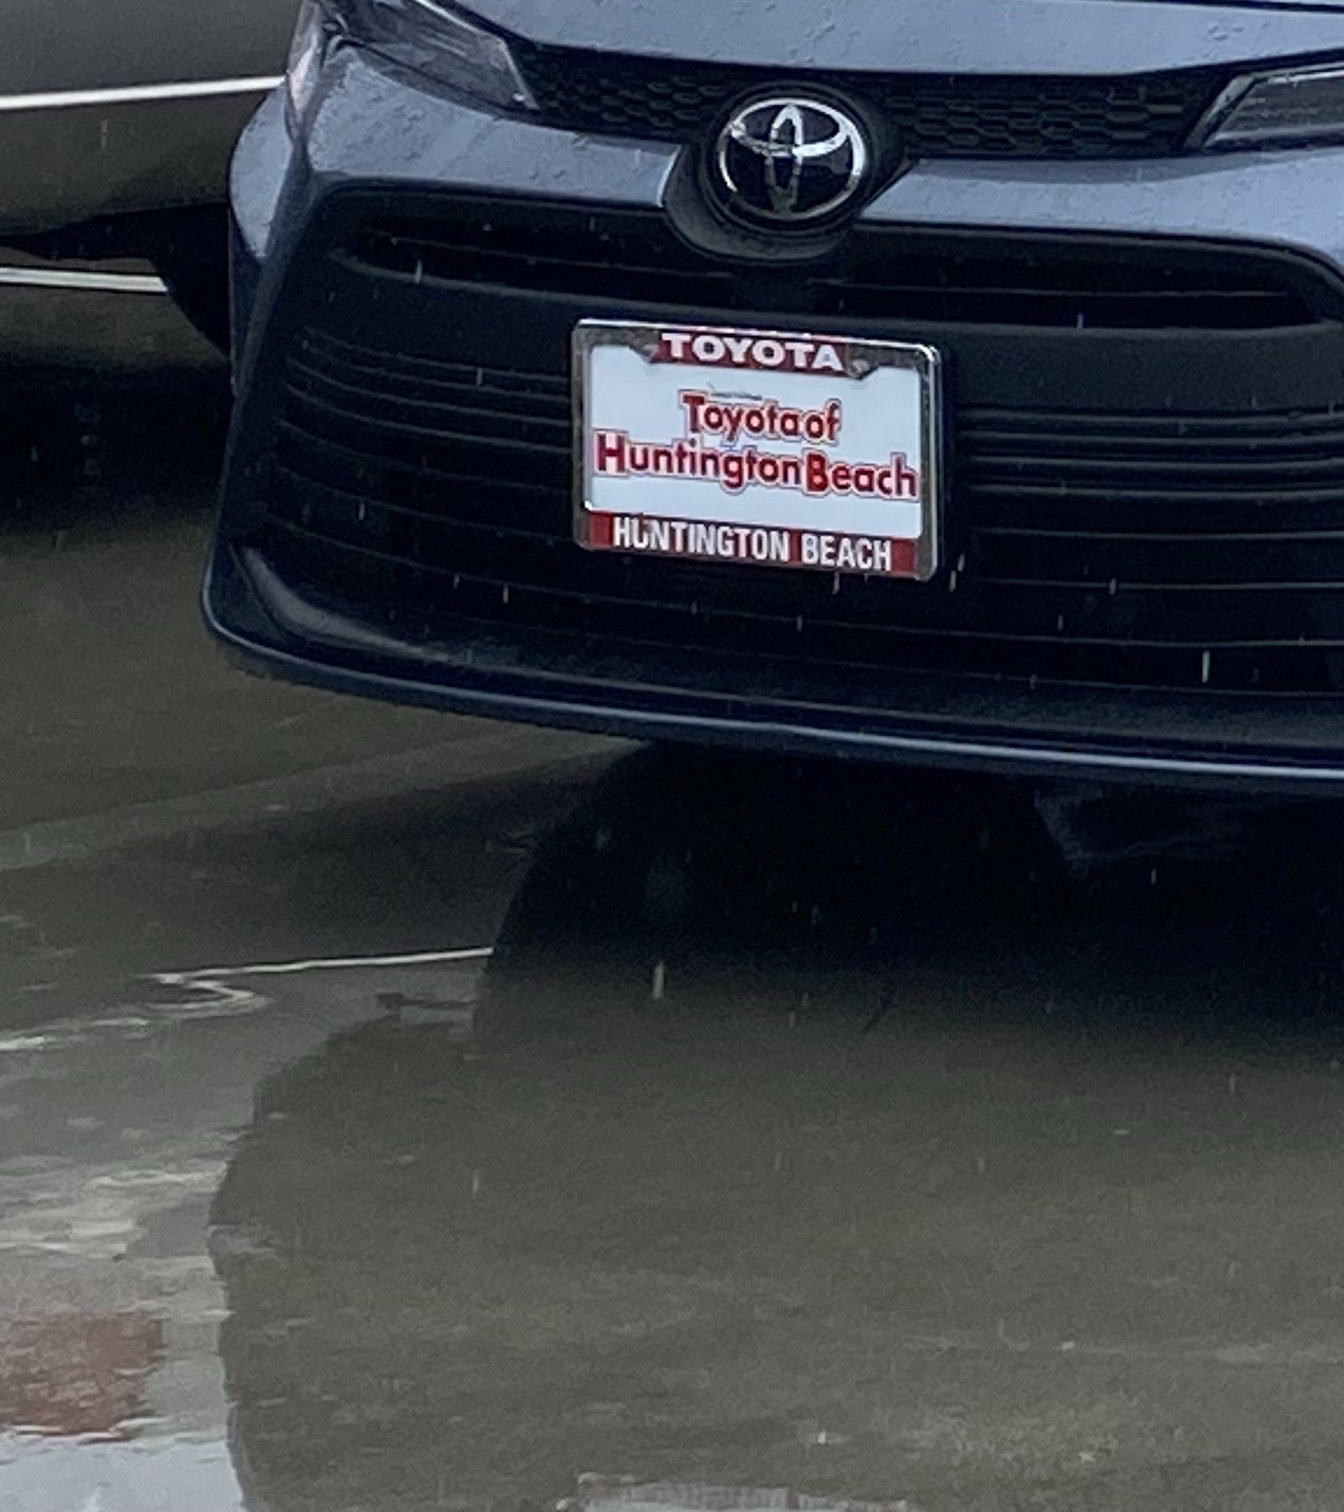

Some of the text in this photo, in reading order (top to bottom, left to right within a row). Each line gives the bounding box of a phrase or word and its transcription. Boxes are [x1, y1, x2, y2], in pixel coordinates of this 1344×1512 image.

[662, 332, 844, 372] TOYOTA
[613, 516, 893, 572] HUNTINGTON BEACH
